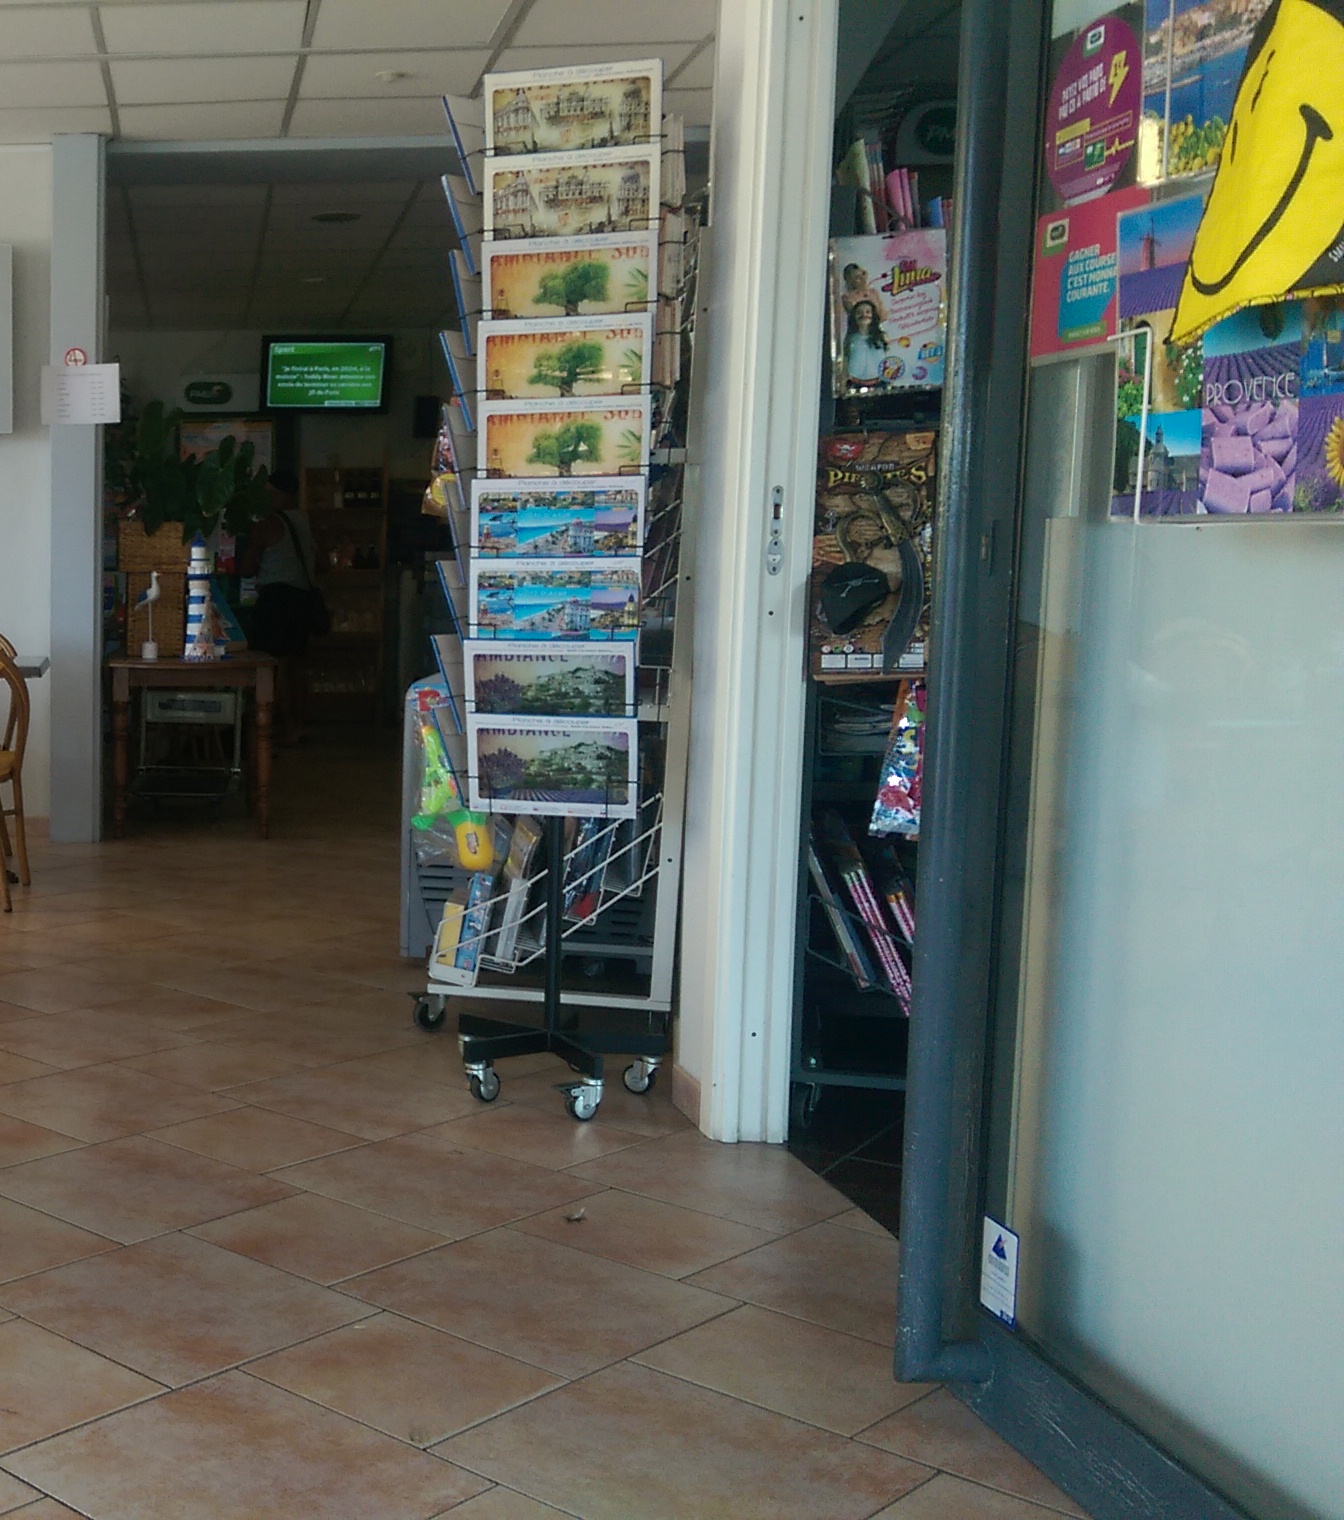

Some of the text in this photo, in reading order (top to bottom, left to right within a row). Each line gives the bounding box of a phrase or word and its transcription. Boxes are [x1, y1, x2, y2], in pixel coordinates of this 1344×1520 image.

[1086, 252, 1117, 271] COURSE
[1206, 372, 1295, 406] PROVENCE
[825, 465, 927, 488] PIRTES
